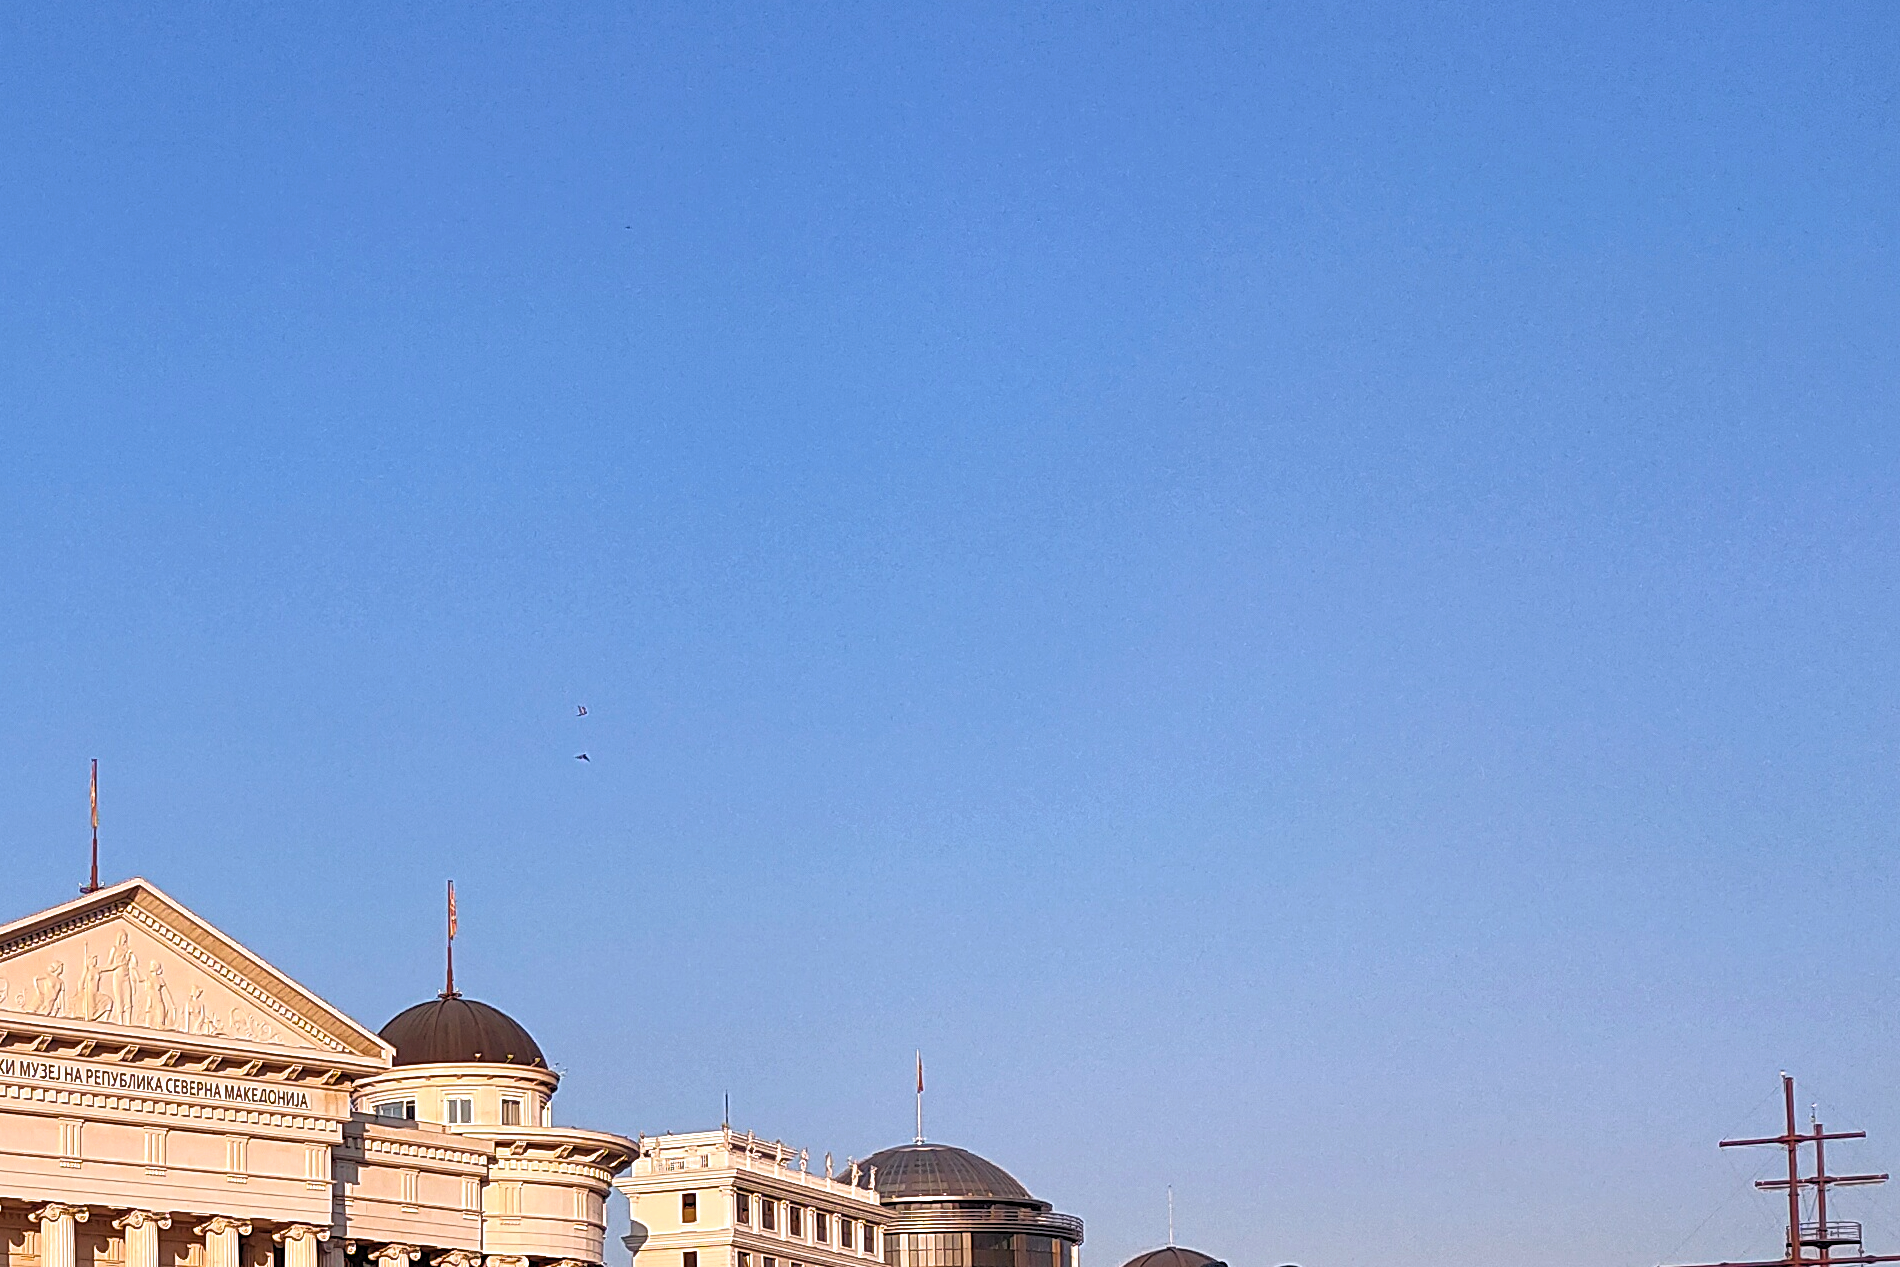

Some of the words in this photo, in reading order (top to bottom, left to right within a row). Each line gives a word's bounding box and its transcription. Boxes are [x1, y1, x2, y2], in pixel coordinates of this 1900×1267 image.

[20, 1061, 61, 1080] МУЗЕЈ
[65, 1066, 83, 1084] НА
[86, 1069, 163, 1092] РЕПУБЛИКА
[166, 1078, 221, 1099] СЕВЕРНА
[224, 1084, 308, 1109] МАКЕДОНИЈА
